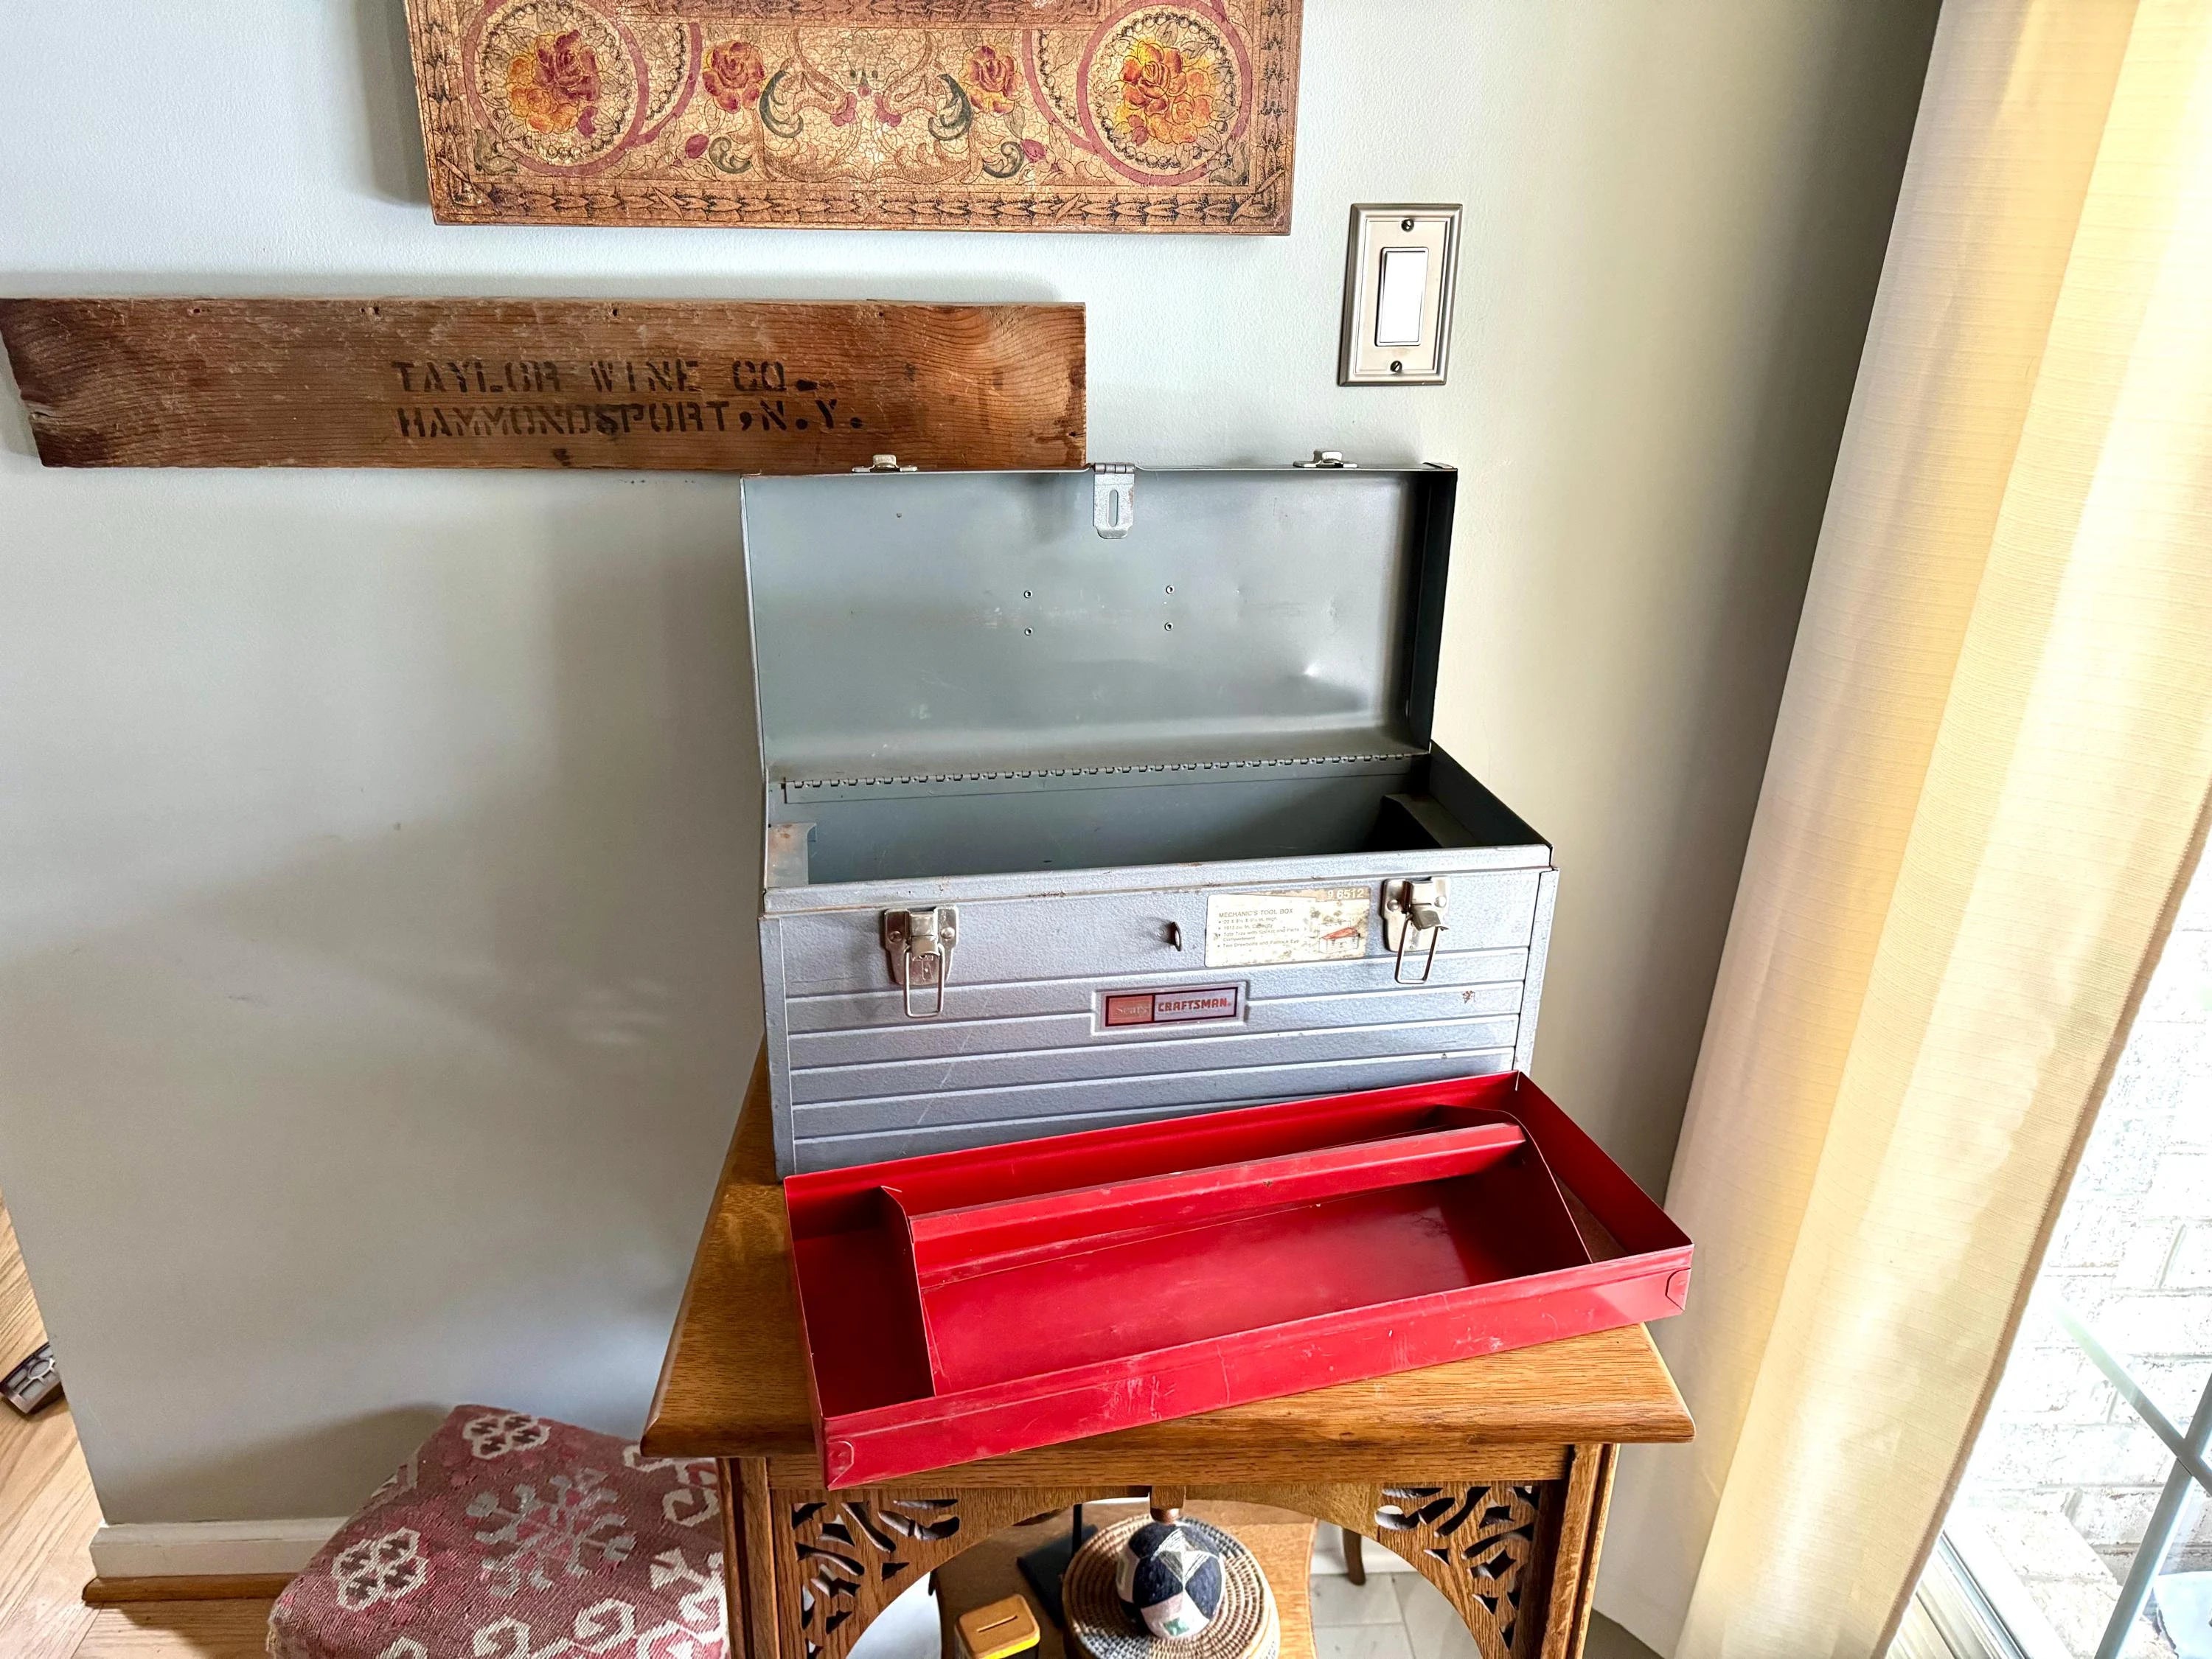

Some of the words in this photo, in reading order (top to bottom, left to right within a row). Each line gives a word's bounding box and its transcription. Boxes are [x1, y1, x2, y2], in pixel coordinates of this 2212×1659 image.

[392, 361, 560, 393] TAYLOR
[590, 358, 700, 393] WINE
[1336, 888, 1364, 899] 6512
[1219, 910, 1258, 918] MECHANIC'S
[1158, 998, 1227, 1012] CRAFTSMAN
